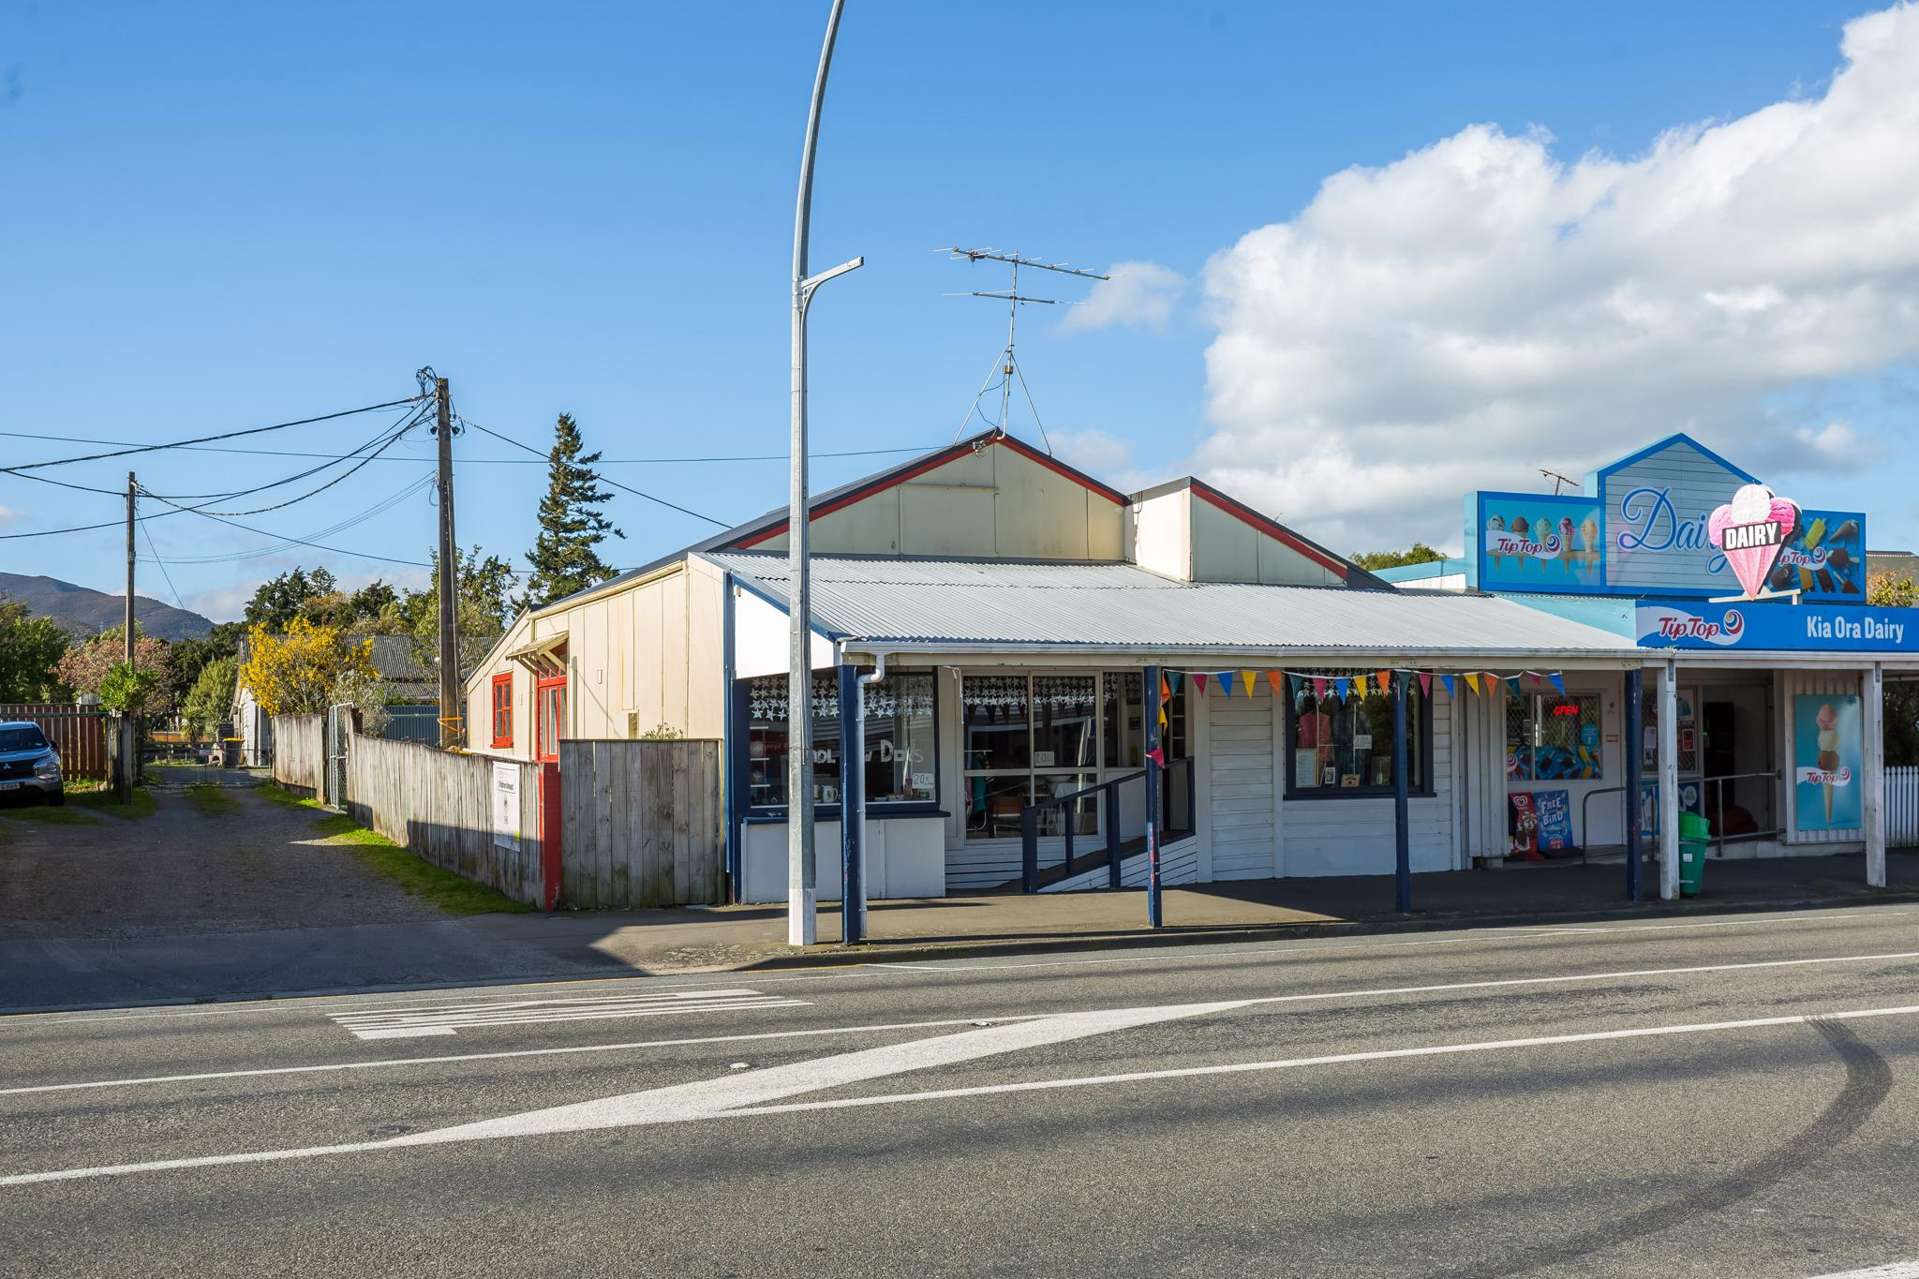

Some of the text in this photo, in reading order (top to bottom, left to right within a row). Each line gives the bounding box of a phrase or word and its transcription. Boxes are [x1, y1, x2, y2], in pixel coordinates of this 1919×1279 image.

[1725, 523, 1778, 549] DAIRY
[1807, 616, 1904, 644] Kia Ora Dairy
[1553, 705, 1580, 716] OPEN
